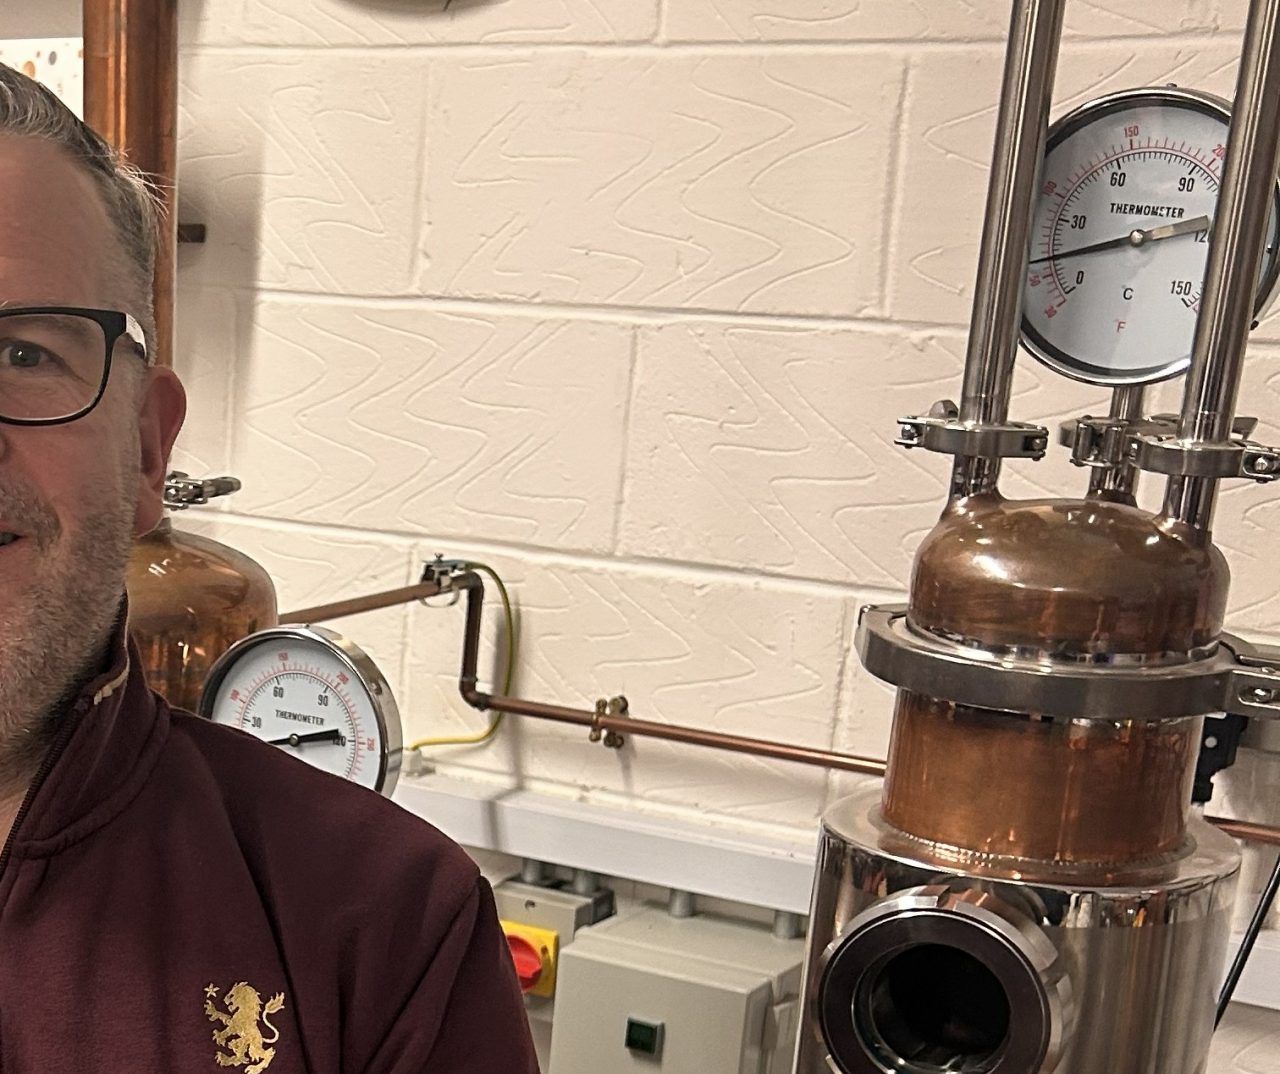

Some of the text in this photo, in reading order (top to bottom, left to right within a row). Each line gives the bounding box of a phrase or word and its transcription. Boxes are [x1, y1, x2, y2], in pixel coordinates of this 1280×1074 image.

[1123, 125, 1139, 138] 150
[1109, 171, 1126, 187] 60
[1177, 177, 1195, 192] 90
[1109, 202, 1185, 219] THERMOMETER
[1070, 214, 1087, 230] 30
[1194, 229, 1211, 243] 12
[1075, 270, 1084, 285] 0
[1170, 280, 1192, 296] 150
[272, 686, 284, 699] 60
[317, 694, 329, 707] 90
[251, 716, 262, 729] 30
[275, 709, 325, 727] THERMOMETER
